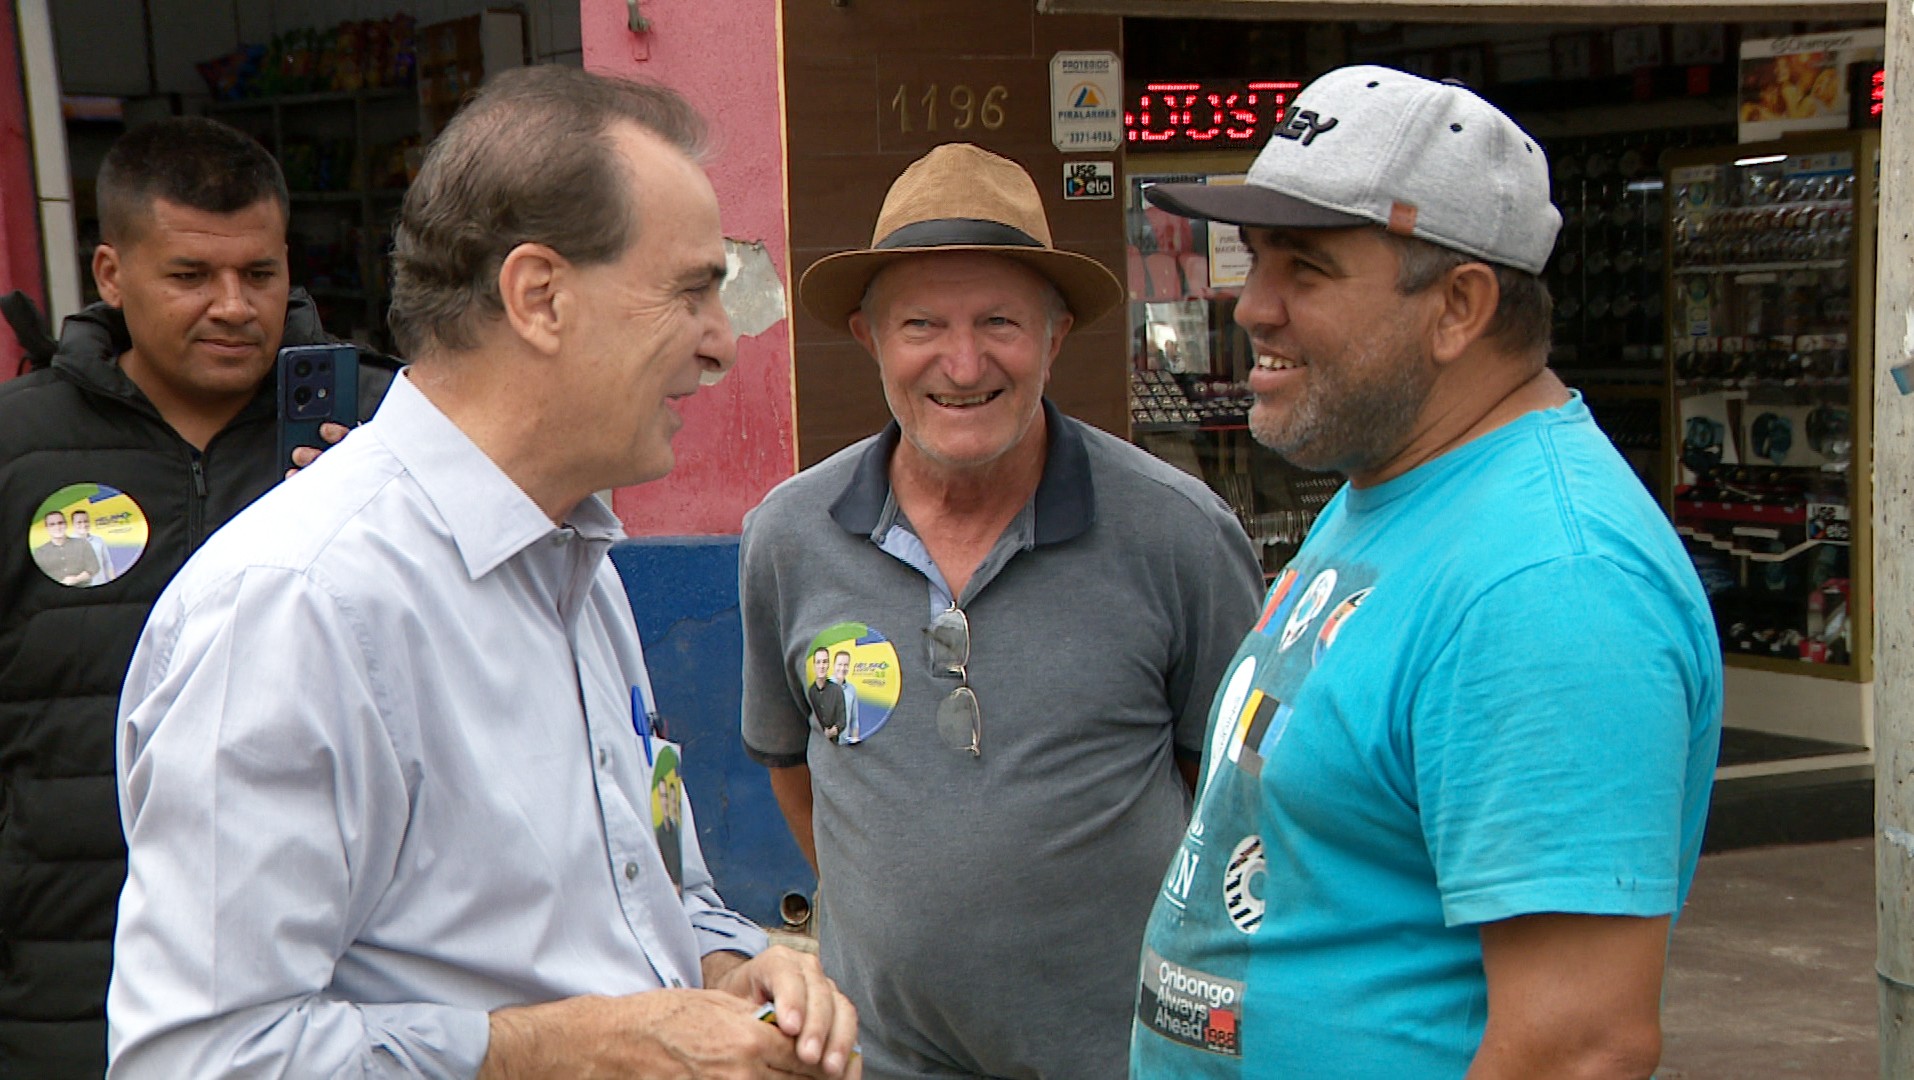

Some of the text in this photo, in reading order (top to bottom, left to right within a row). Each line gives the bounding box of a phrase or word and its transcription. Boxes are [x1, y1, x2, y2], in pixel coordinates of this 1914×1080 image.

[892, 84, 1009, 133] 1196
[1058, 109, 1117, 120] PIRALARMES
[1086, 179, 1110, 194] elo
[1156, 984, 1209, 1022] Always
[1159, 962, 1235, 1008] Onbongo
[1154, 1006, 1203, 1041] Ahead
